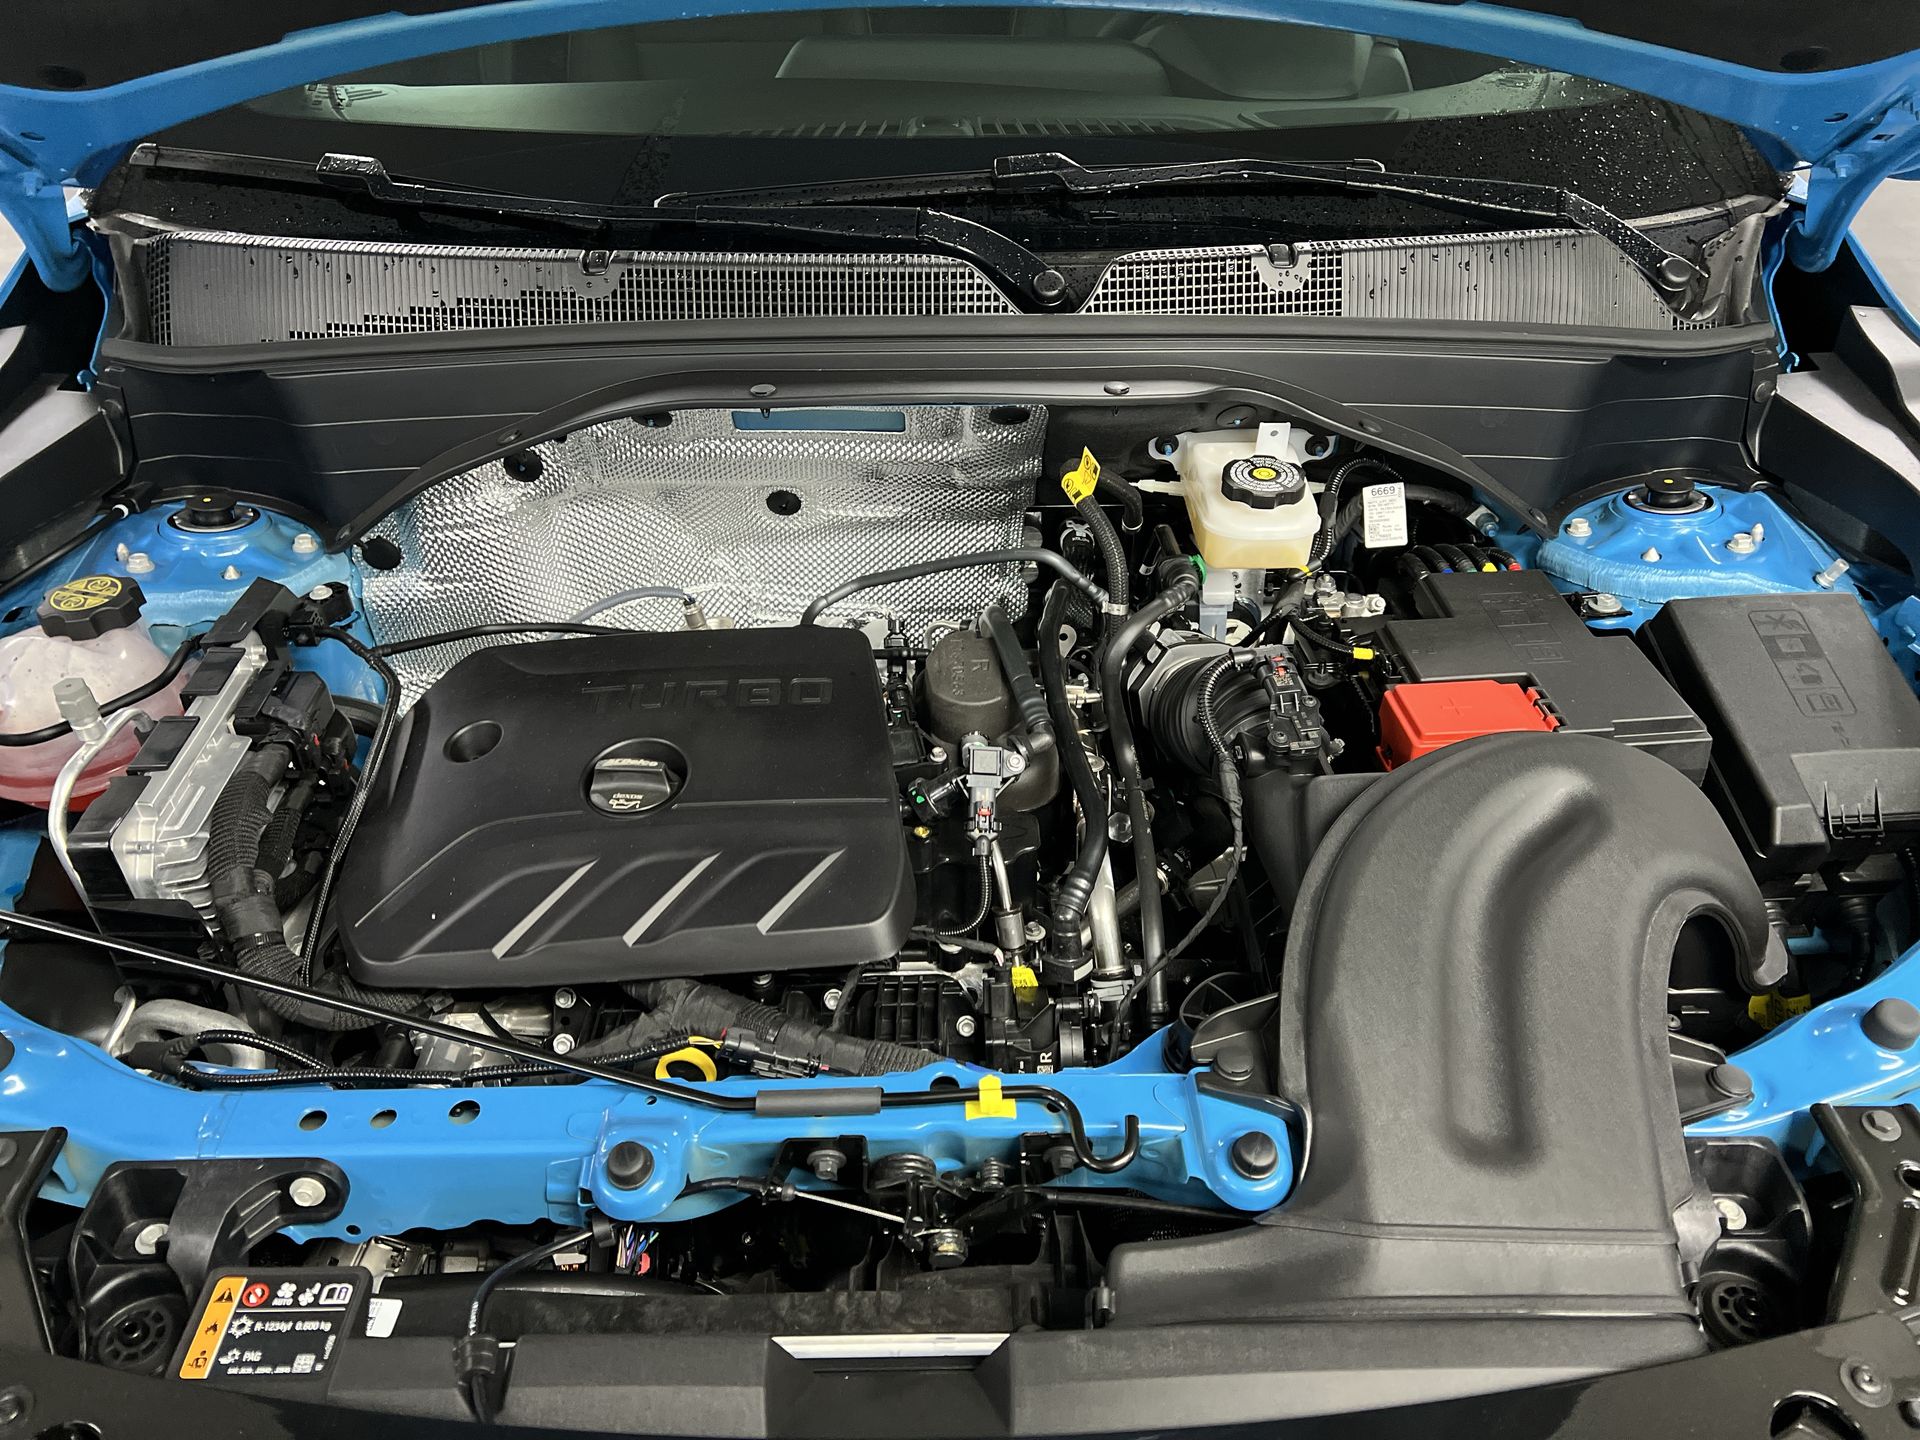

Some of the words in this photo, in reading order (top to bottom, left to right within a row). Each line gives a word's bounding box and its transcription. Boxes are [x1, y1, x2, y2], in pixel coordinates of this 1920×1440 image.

[1371, 485, 1396, 497] 6669
[582, 677, 834, 713] TURBO
[602, 757, 659, 767] ACDelco
[1039, 1051, 1053, 1063] R
[271, 1298, 293, 1306] AUTO
[254, 1320, 293, 1332] R-1234yf
[319, 1320, 332, 1332] kg
[242, 1350, 262, 1362] PAG
